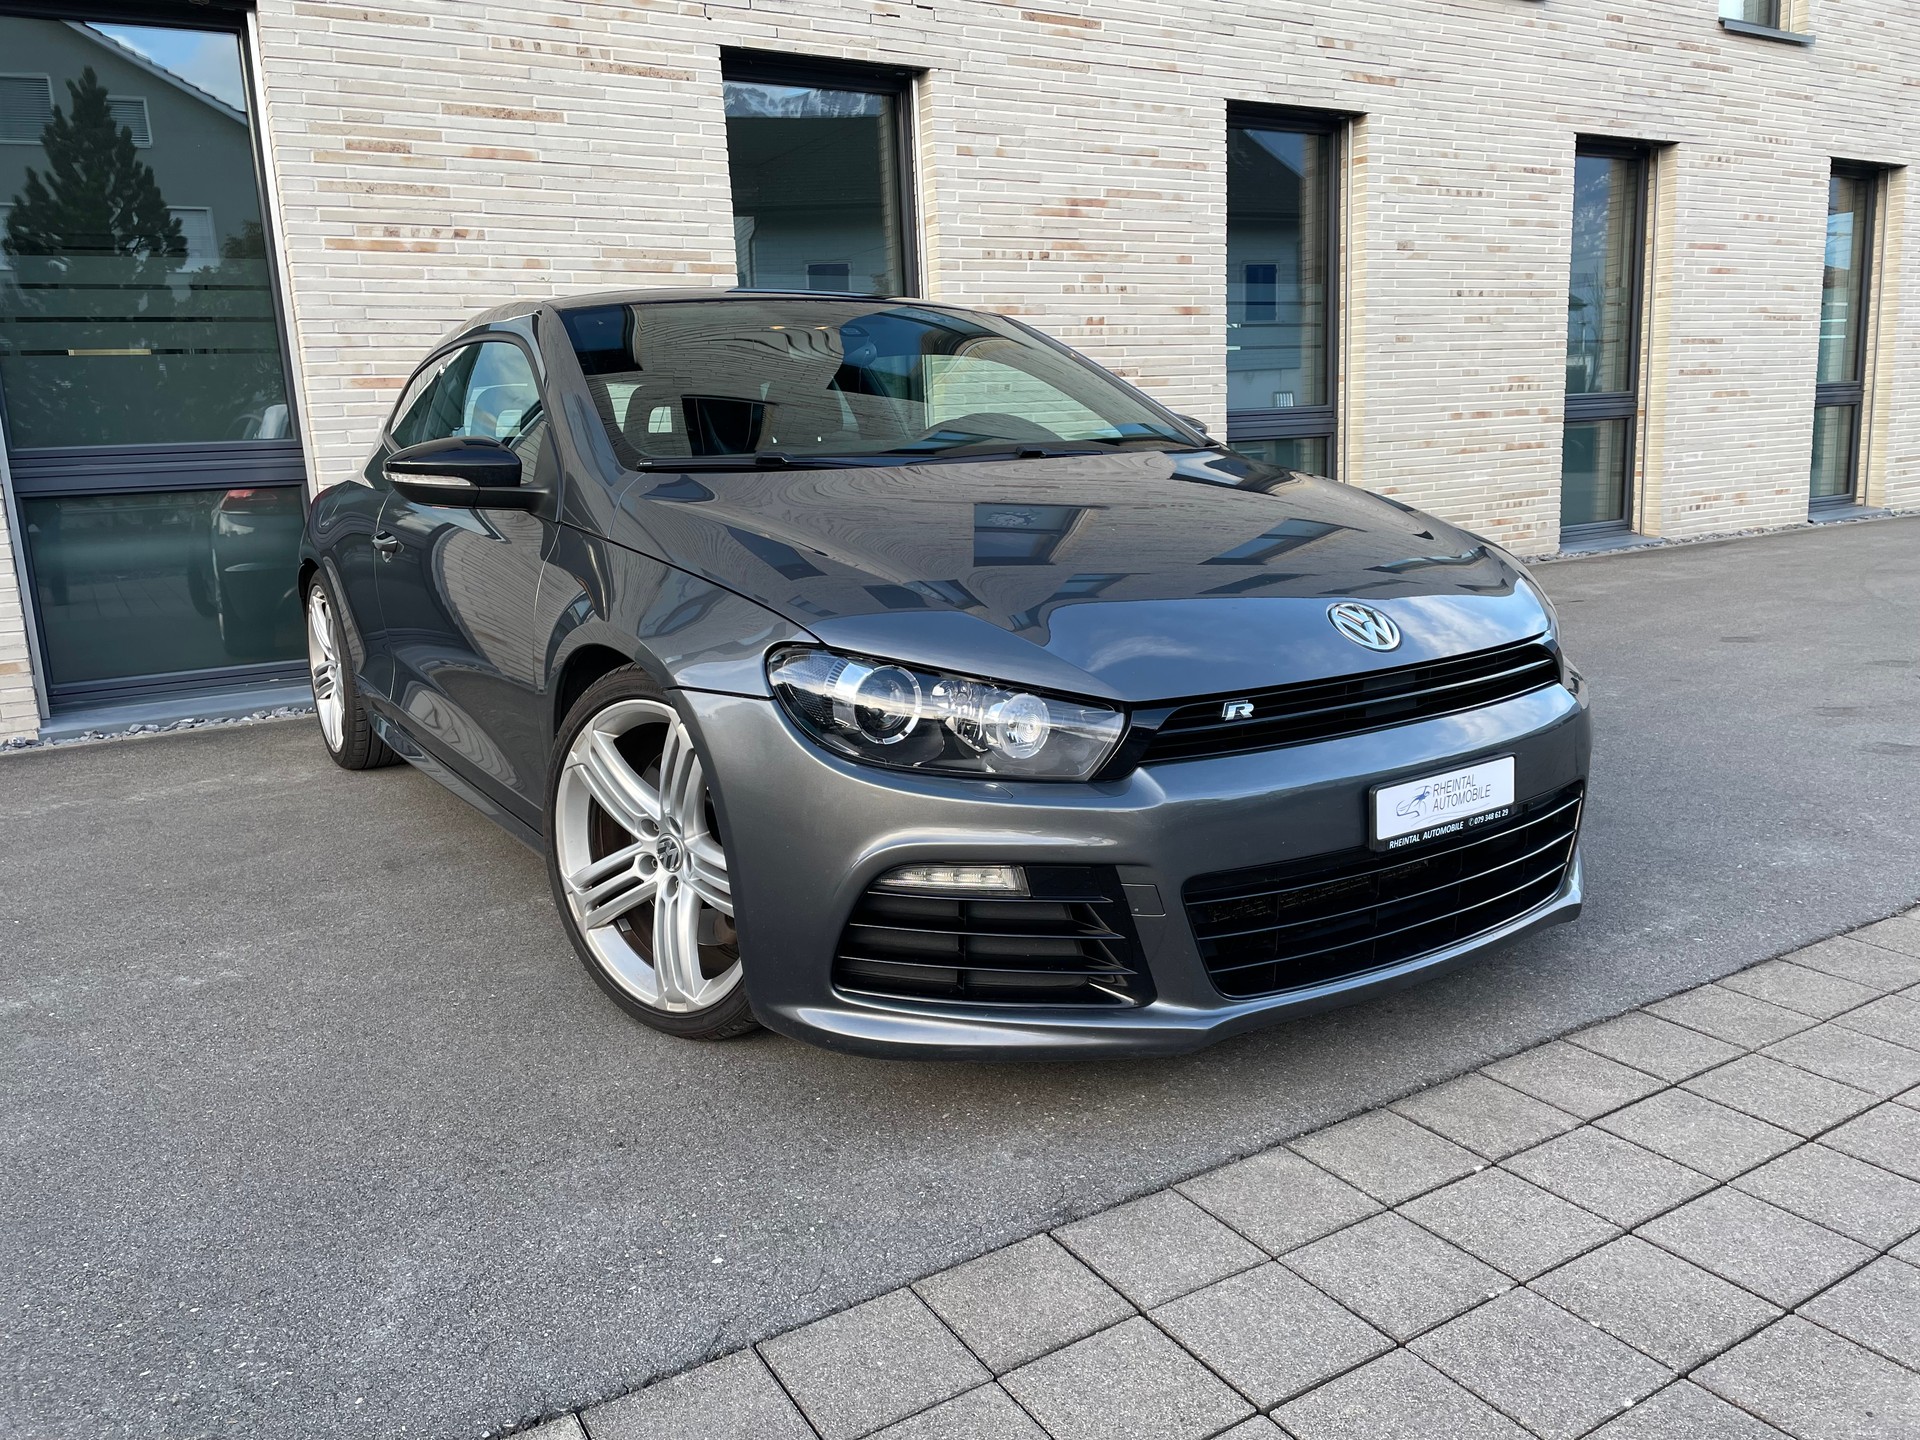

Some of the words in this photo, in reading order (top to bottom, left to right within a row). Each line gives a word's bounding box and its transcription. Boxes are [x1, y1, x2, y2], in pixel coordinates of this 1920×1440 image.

[1222, 700, 1255, 721] R
[1432, 774, 1476, 798] RHEINTAL
[1432, 784, 1491, 812] AUTOMOBILE
[1389, 834, 1420, 849] RHEINTAL
[1422, 821, 1464, 840] AUTOMOBILE
[1502, 808, 1509, 817] 29
